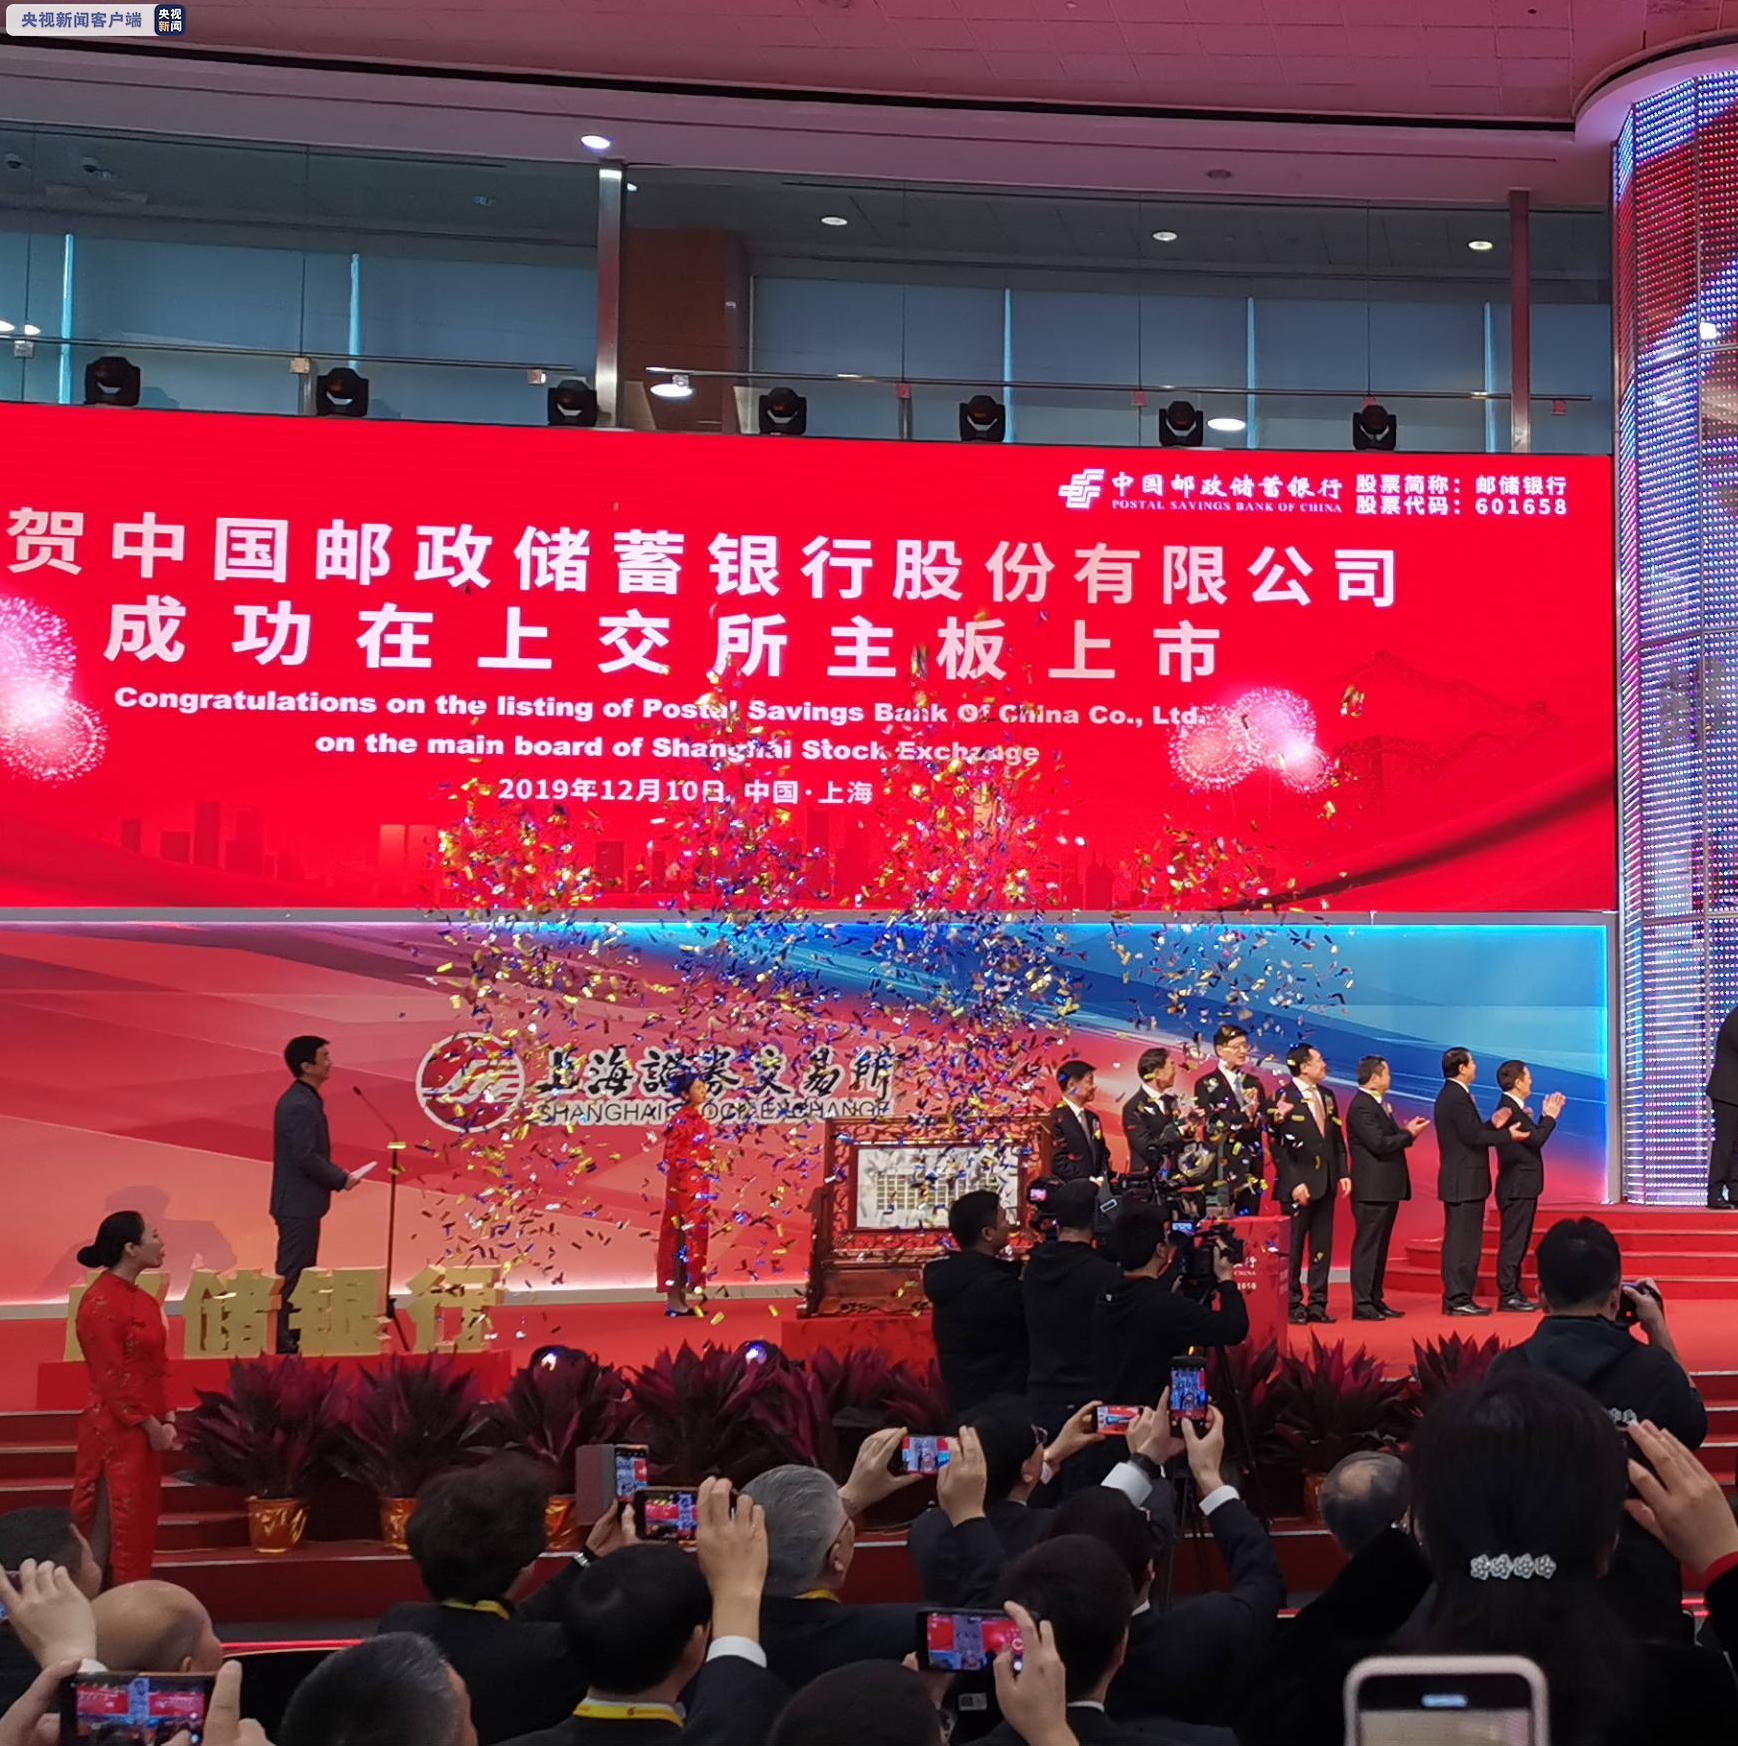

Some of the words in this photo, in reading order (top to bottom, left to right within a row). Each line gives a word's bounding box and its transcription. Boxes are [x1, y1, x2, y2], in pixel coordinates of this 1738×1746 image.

[1111, 471, 1344, 499] 中国邮政储蓄银行
[1112, 499, 1165, 510] POSTAL
[1170, 500, 1231, 511] SAVINGS
[1236, 502, 1273, 512] BANK
[1277, 503, 1296, 512] OF
[1299, 503, 1343, 513] CHINA
[7, 506, 1396, 608] 贺中国邮政储蓄银行股份有限公司
[104, 595, 1221, 684] 成功在上交所主板上市
[115, 687, 377, 713] Congratulations
[386, 697, 426, 714] on
[434, 694, 487, 716] the
[497, 695, 593, 722] listing
[602, 697, 635, 718] of
[642, 698, 737, 720] Postal
[748, 700, 865, 726] Savings
[874, 702, 948, 722] Bank
[957, 703, 992, 722] Of
[998, 704, 1080, 724] China
[1088, 705, 1143, 728] Co.,
[1153, 705, 1206, 726] Ltd.
[315, 736, 355, 753] on
[364, 732, 418, 754] the
[427, 734, 504, 755] main
[514, 735, 603, 757] board
[612, 736, 644, 757] of
[651, 737, 792, 763] Shanghai
[801, 738, 888, 761] Stock
[897, 741, 1040, 766] Exchange
[498, 777, 727, 803] 2019年12月10日
[536, 1102, 662, 1122] SHANGHAI
[667, 1101, 748, 1122] OCK
[64, 1264, 502, 1361] 储银行
